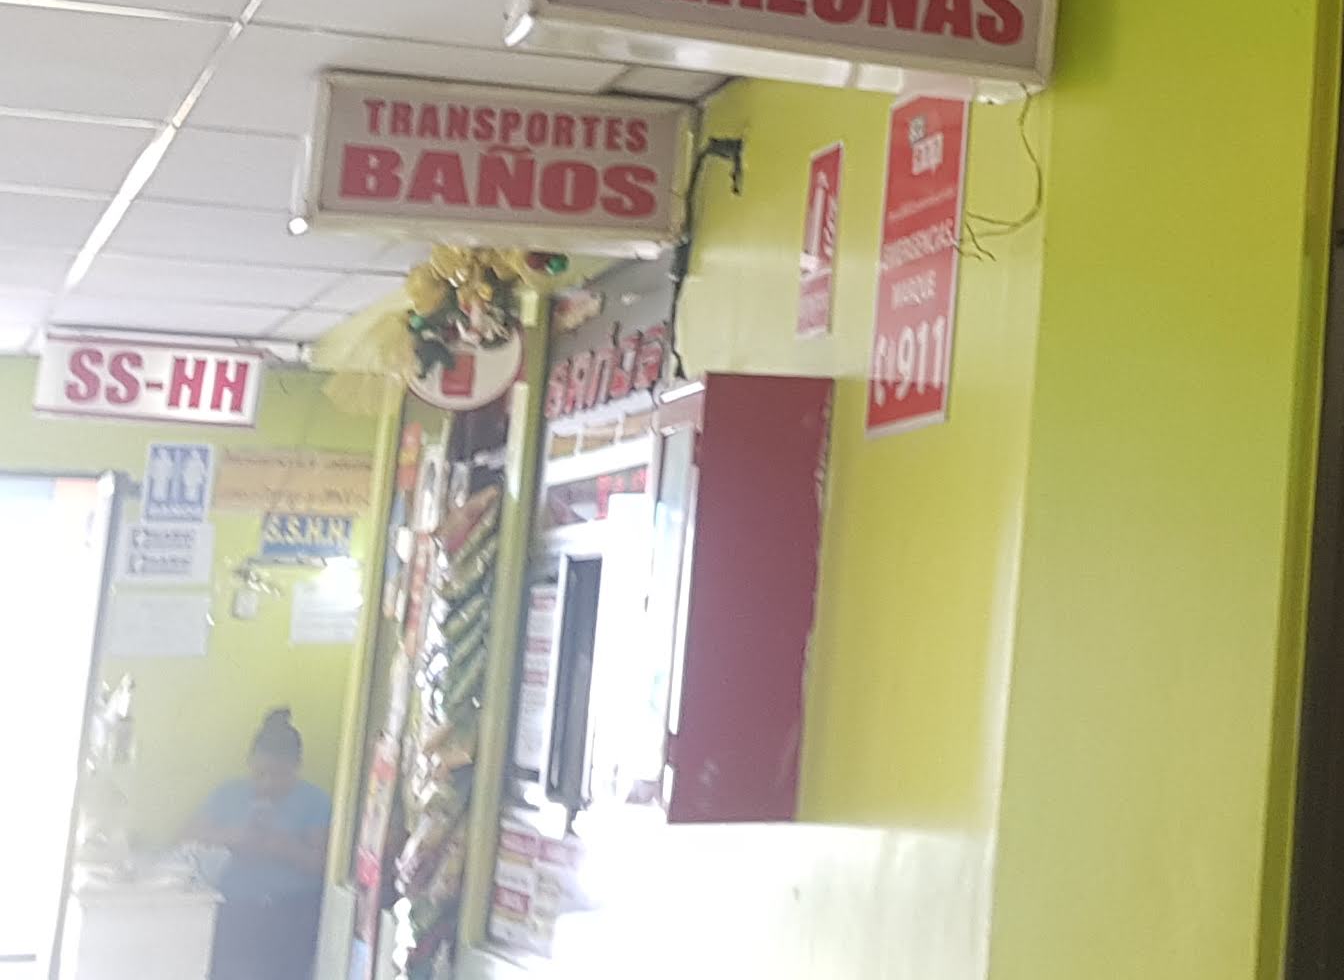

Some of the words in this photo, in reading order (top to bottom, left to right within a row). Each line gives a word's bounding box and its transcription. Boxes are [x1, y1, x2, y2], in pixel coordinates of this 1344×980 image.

[364, 99, 649, 155] TRANSPORTES
[338, 143, 659, 219] BAÑOS
[64, 347, 250, 413] SS-HH
[896, 316, 946, 401] 911
